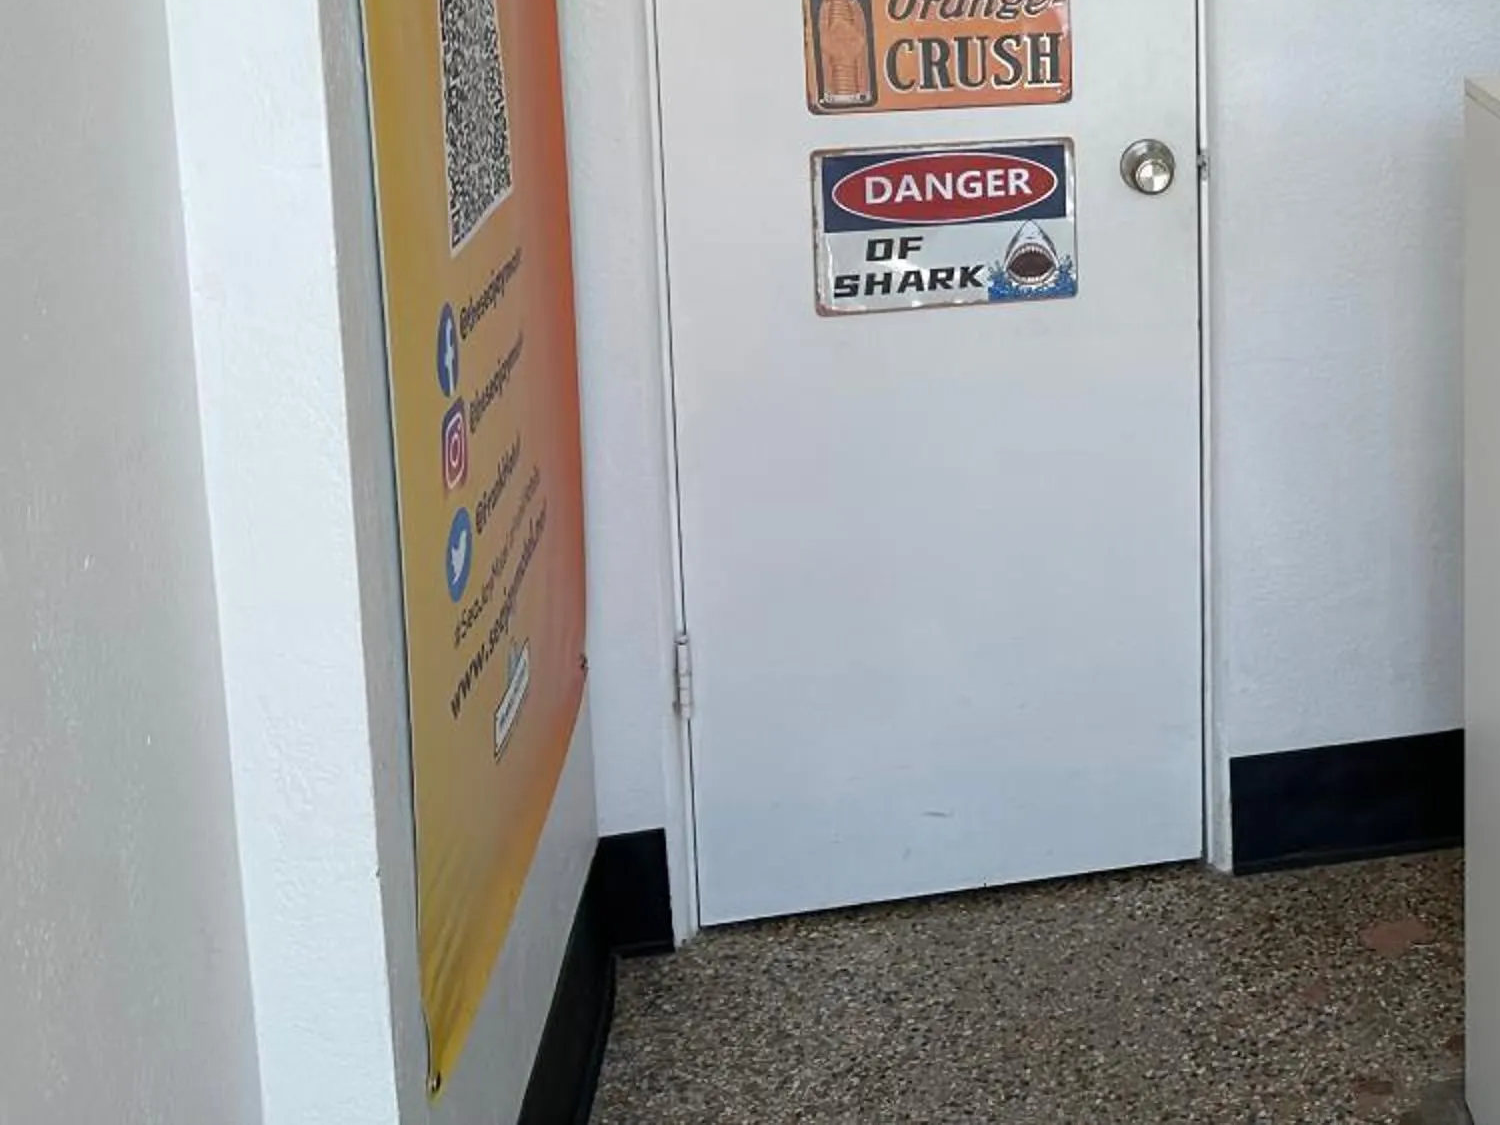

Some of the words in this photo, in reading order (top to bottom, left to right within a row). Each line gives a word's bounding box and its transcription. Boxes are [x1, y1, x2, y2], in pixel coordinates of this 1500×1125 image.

[884, 31, 1065, 93] CRUSH
[864, 167, 1033, 205] DANGER
[866, 236, 924, 262] OF
[833, 264, 986, 298] SHARK
